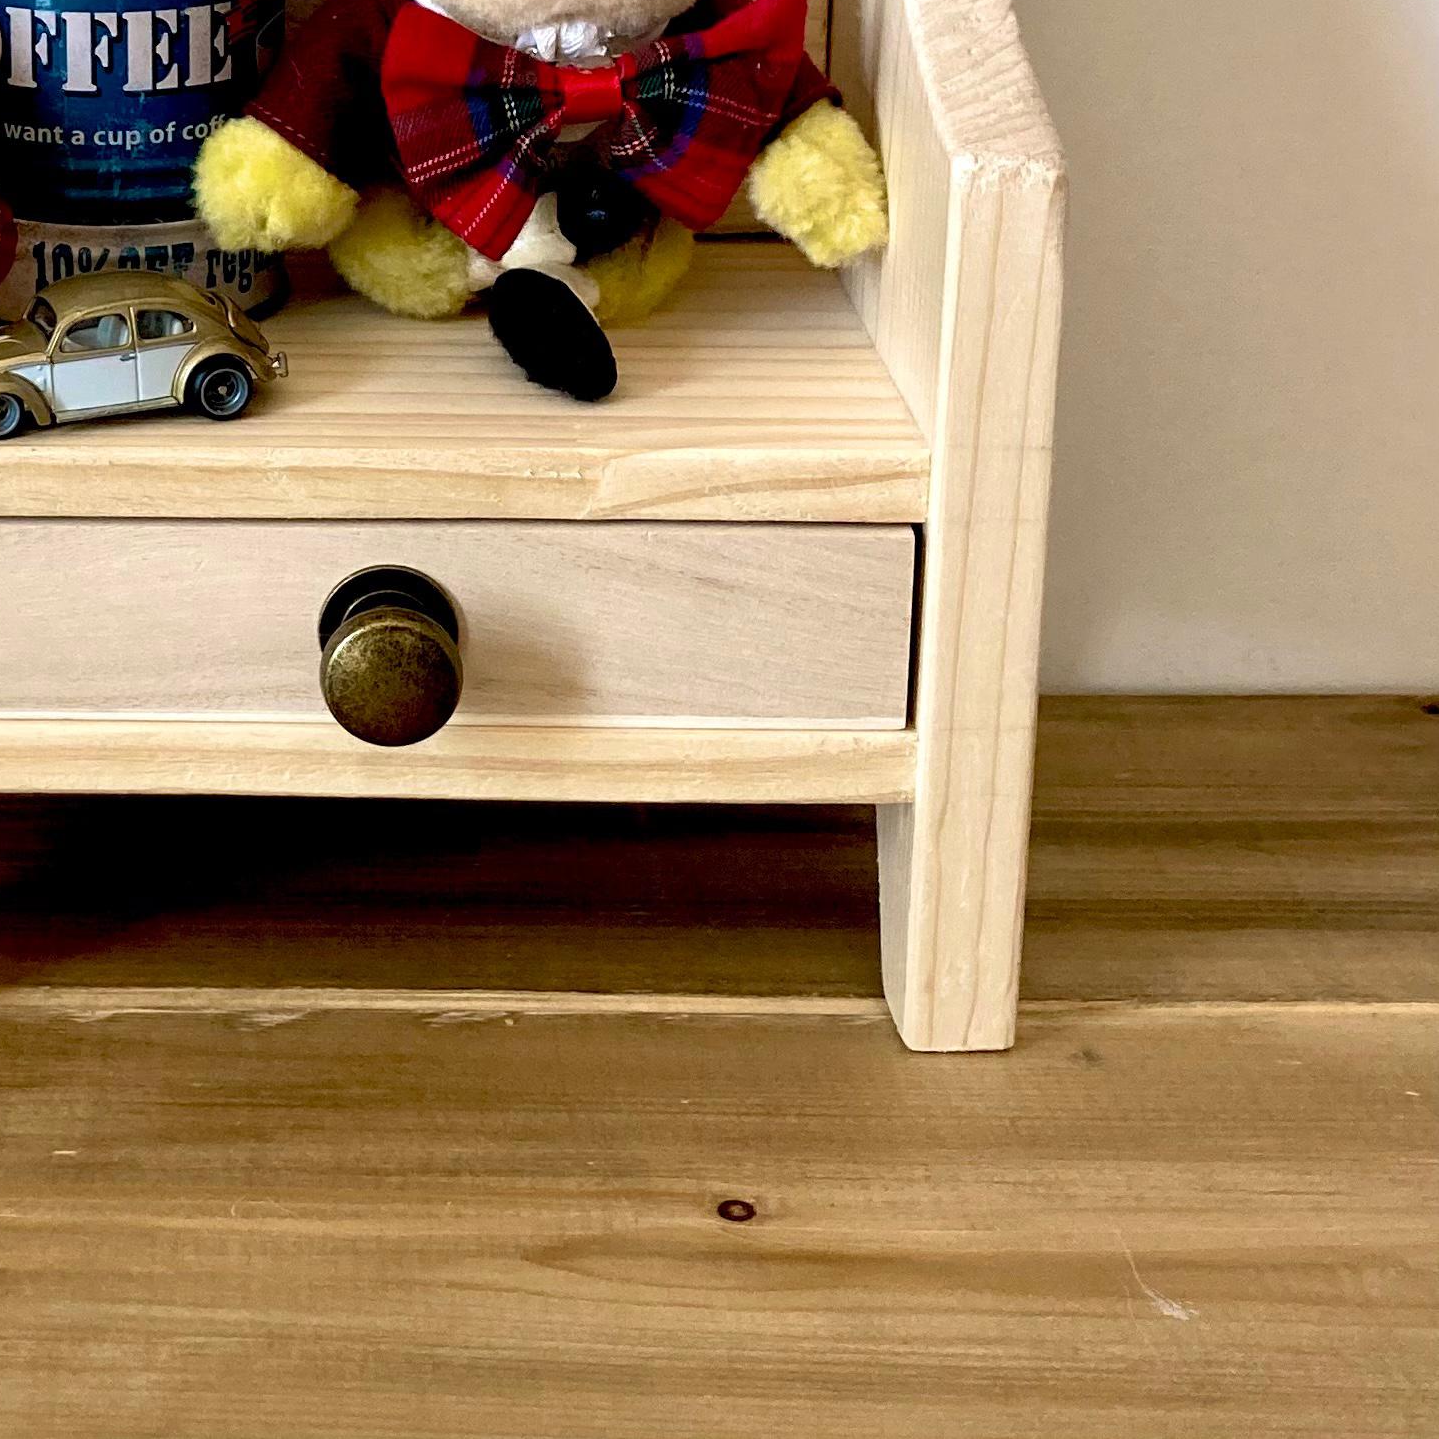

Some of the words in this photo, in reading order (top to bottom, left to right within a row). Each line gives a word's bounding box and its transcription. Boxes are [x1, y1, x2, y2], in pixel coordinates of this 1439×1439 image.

[4, 121, 63, 145] want
[71, 129, 85, 146] a
[93, 129, 141, 150] cup
[149, 121, 176, 144] of
[182, 113, 227, 141] coff
